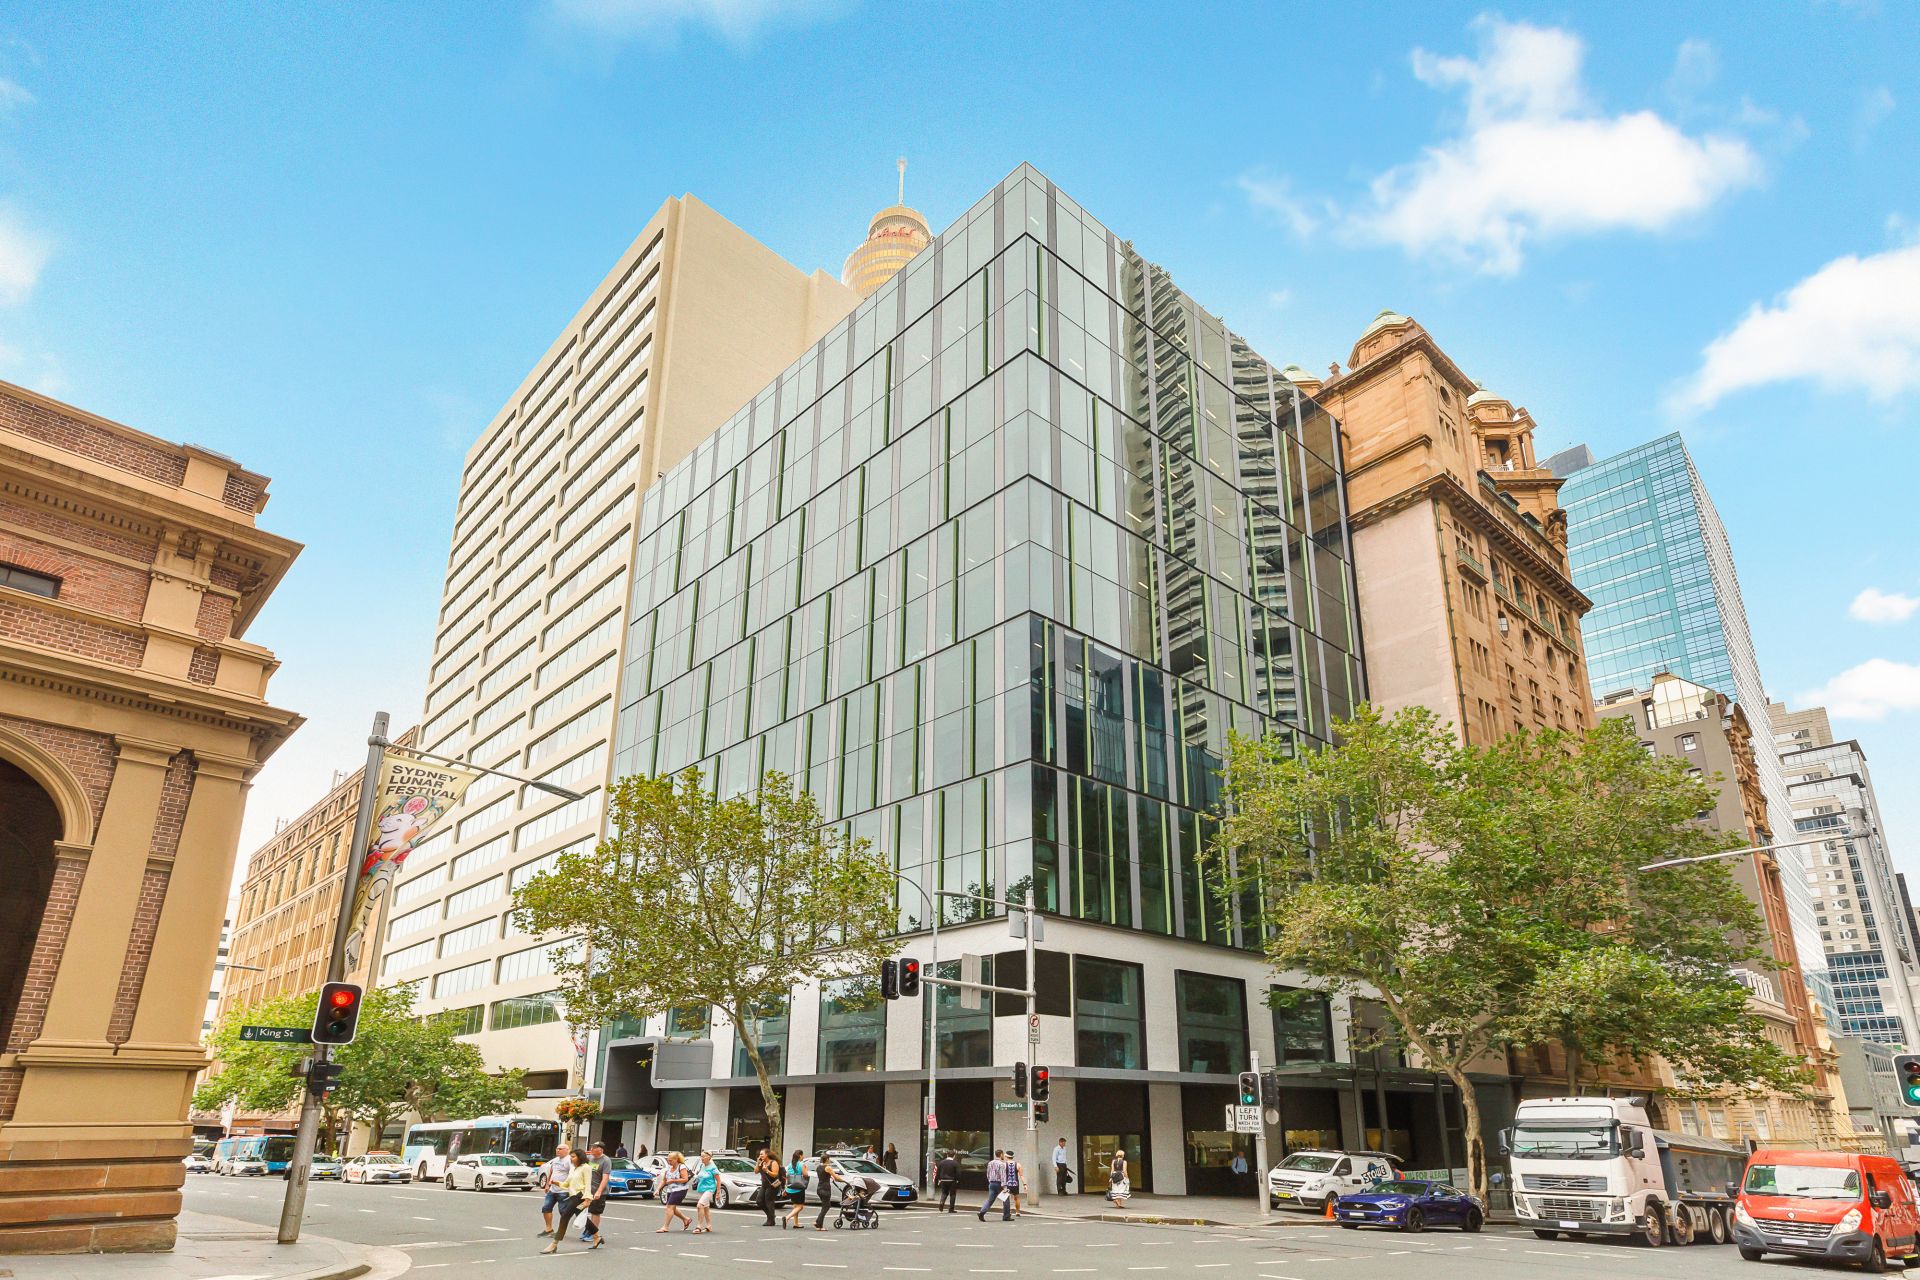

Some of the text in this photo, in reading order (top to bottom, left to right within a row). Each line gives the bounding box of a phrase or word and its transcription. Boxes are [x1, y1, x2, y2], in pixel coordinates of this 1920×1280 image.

[392, 765, 458, 783] SYDNEY
[389, 775, 445, 788] LUNAR
[385, 785, 457, 800] FESTIVAL
[260, 1028, 294, 1038] King St
[1361, 1164, 1388, 1185] STOWE
[1415, 1171, 1428, 1180] FOR
